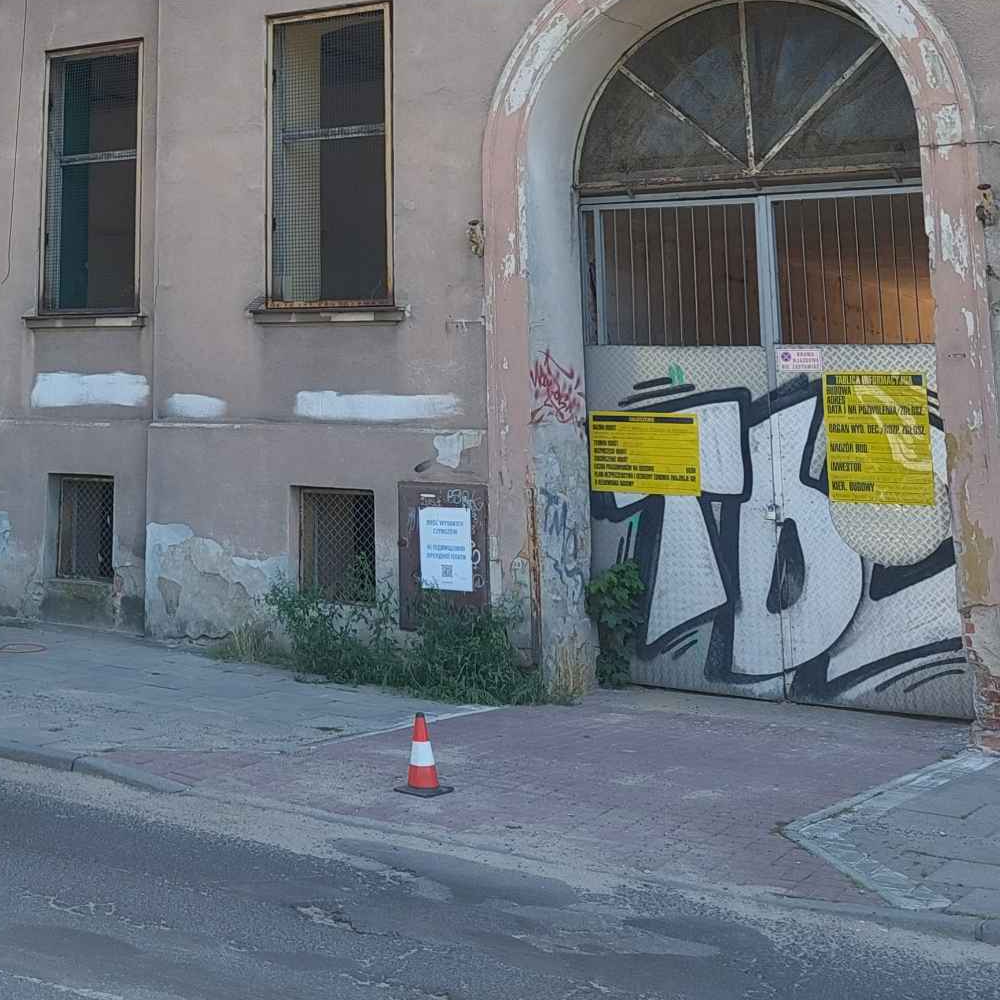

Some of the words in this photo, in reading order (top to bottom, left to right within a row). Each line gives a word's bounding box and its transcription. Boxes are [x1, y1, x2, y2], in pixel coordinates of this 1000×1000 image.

[836, 375, 860, 385] TABLICA
[826, 386, 851, 395] BUDOWA
[827, 405, 843, 414] DATA
[829, 424, 850, 433] ORGAN
[831, 461, 862, 472] INWESTOR
